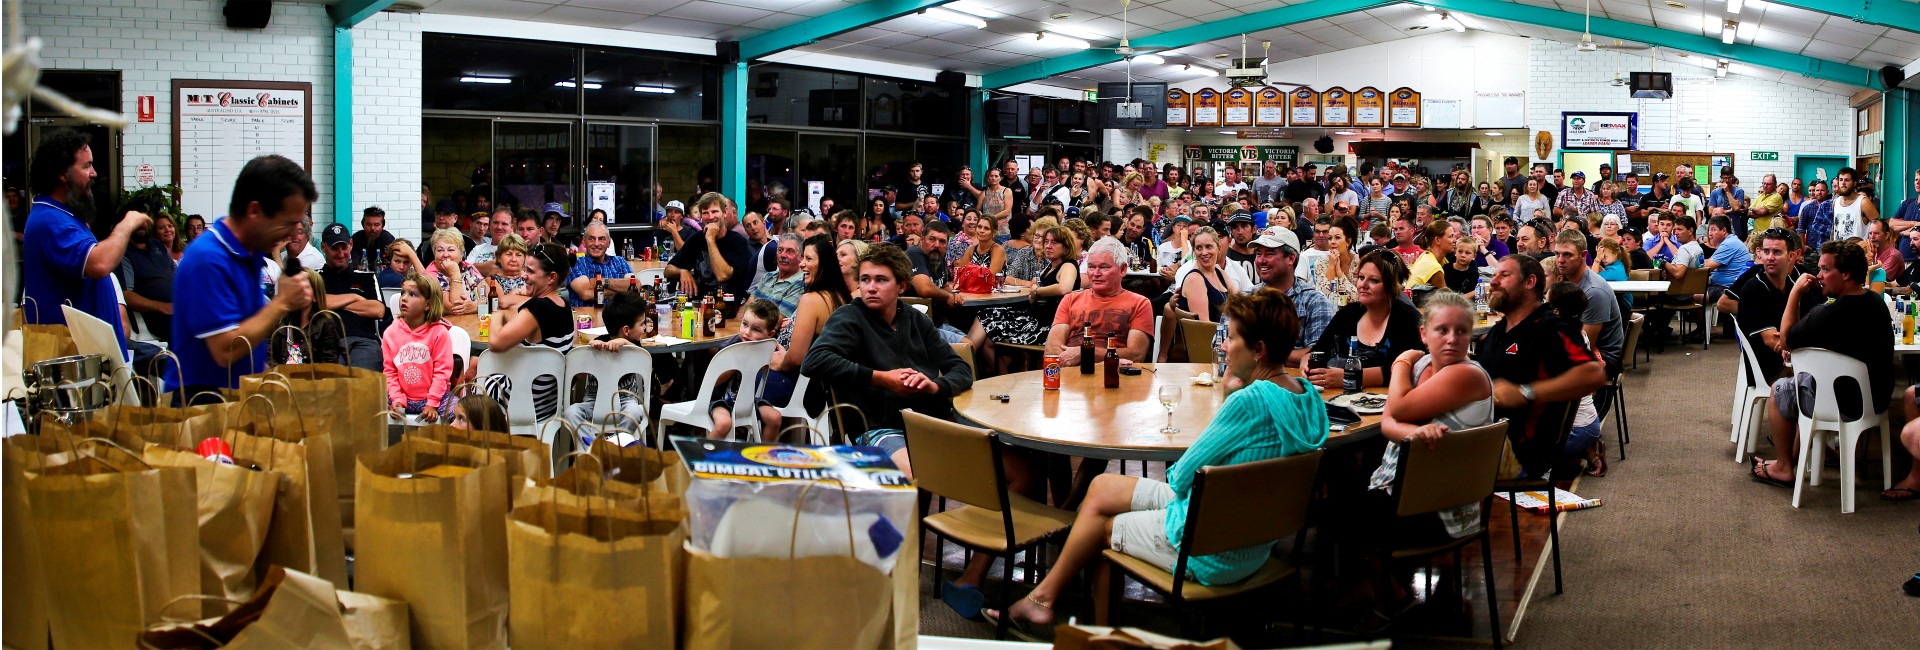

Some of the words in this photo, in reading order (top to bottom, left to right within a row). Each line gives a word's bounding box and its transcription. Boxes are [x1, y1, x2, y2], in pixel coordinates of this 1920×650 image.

[217, 92, 255, 107] Classic
[256, 92, 299, 108] Cabinets
[1186, 149, 1201, 158] VB
[1241, 149, 1256, 158] VB
